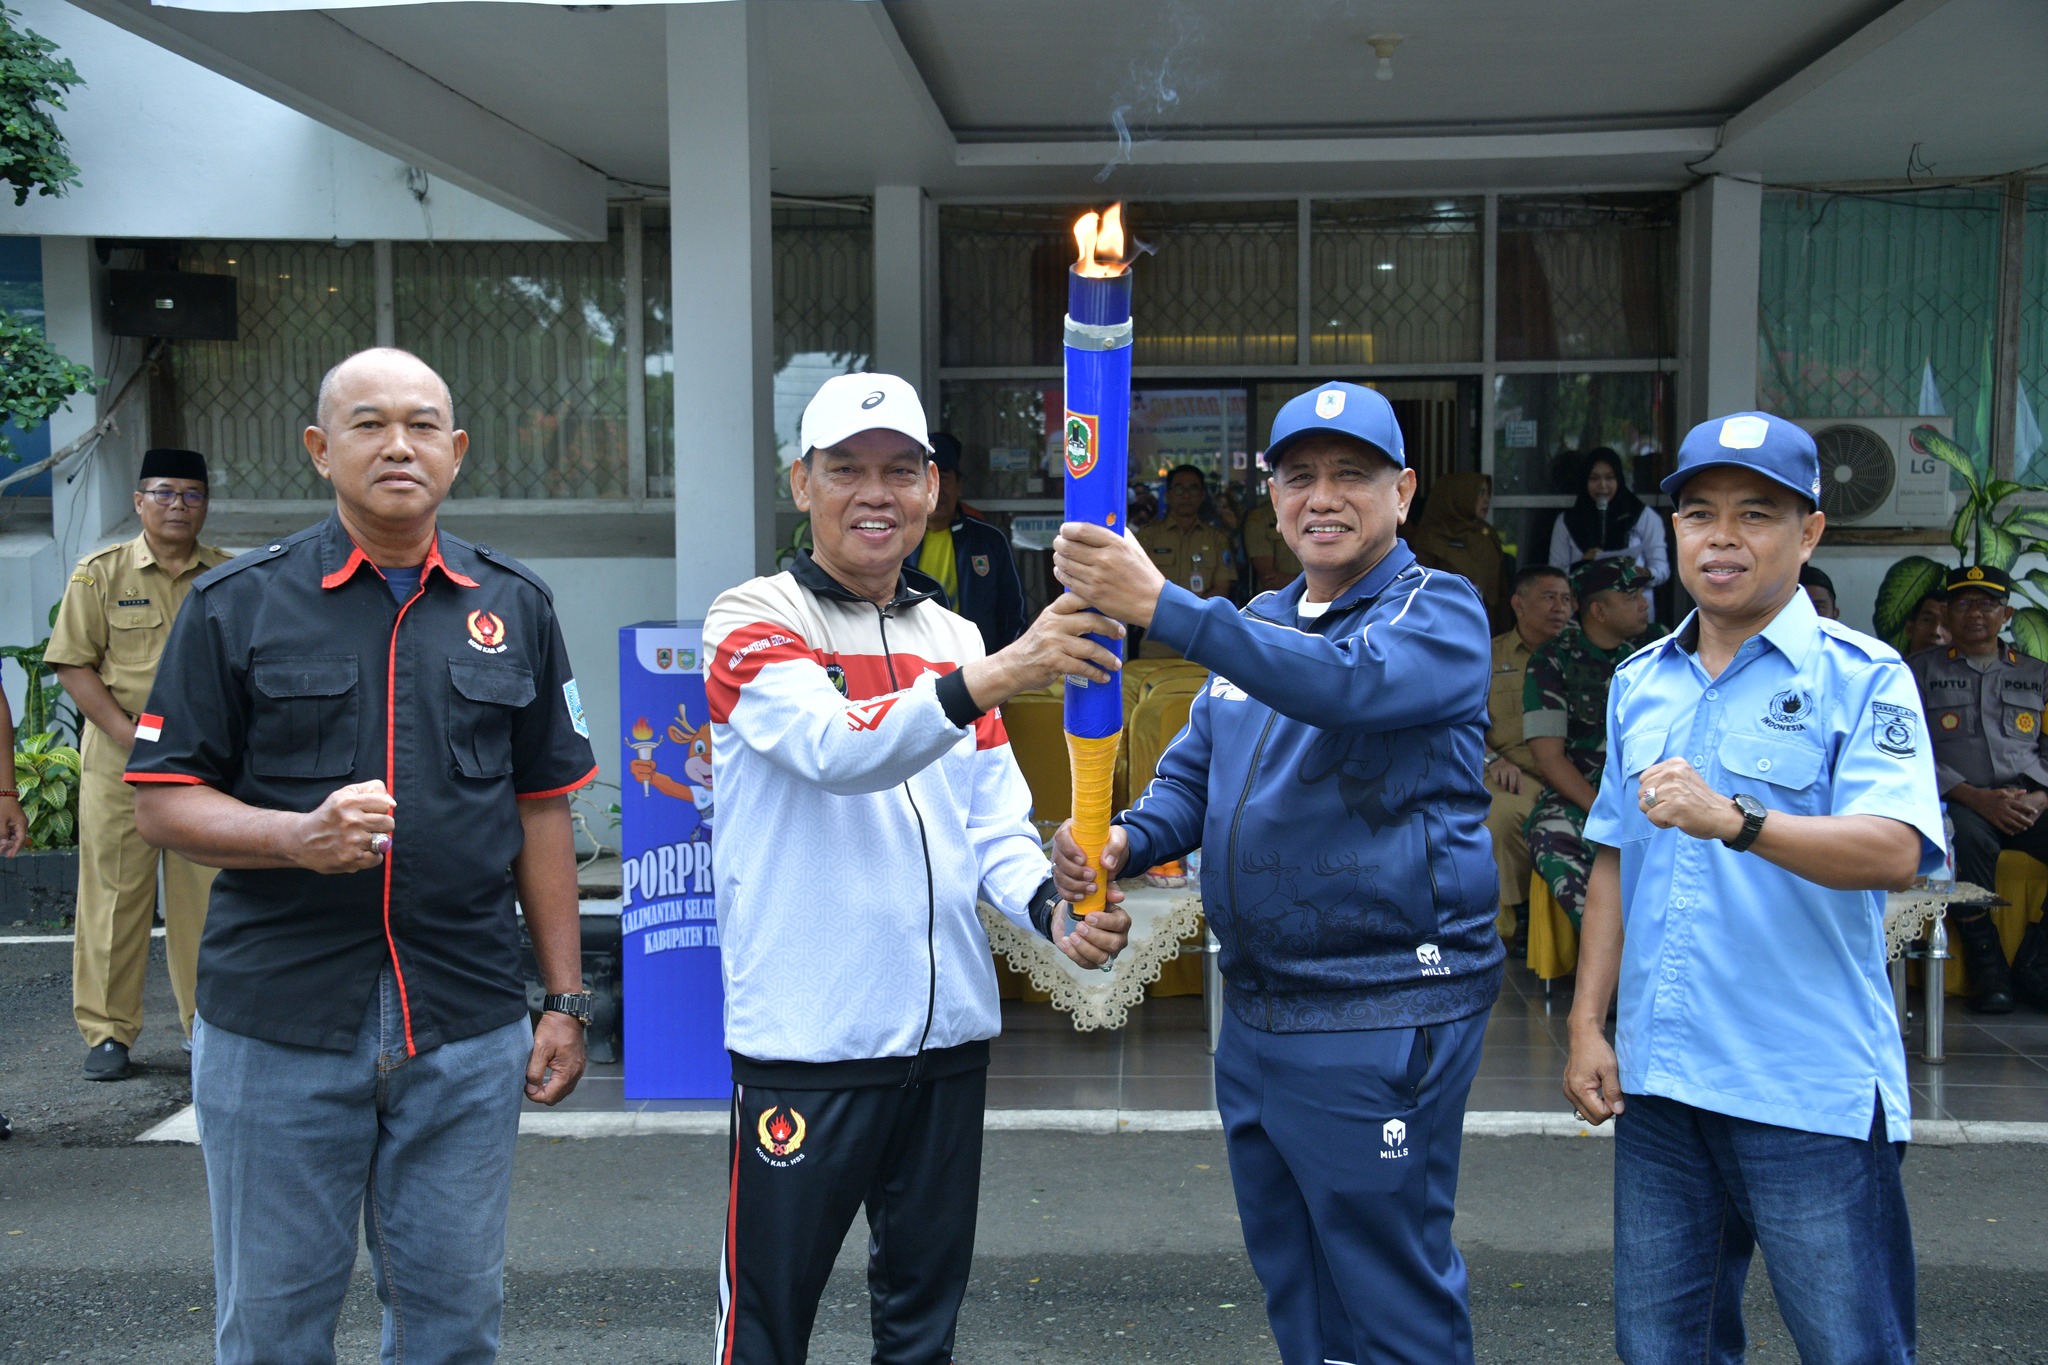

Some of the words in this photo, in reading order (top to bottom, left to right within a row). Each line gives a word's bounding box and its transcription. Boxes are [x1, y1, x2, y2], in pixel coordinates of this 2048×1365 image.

[1910, 459, 1936, 475] LG
[1929, 680, 1967, 690] PUTU
[2004, 680, 2043, 692] POLRI
[1760, 716, 1807, 731] INDONESIA
[684, 898, 717, 920] SELAT
[644, 926, 704, 954] KABUPATEN
[1421, 966, 1451, 977] MILLS
[755, 1146, 770, 1164] KONI
[770, 1159, 789, 1168] KAB.
[790, 1152, 806, 1166] HSS
[1380, 1147, 1409, 1159] MILLS
